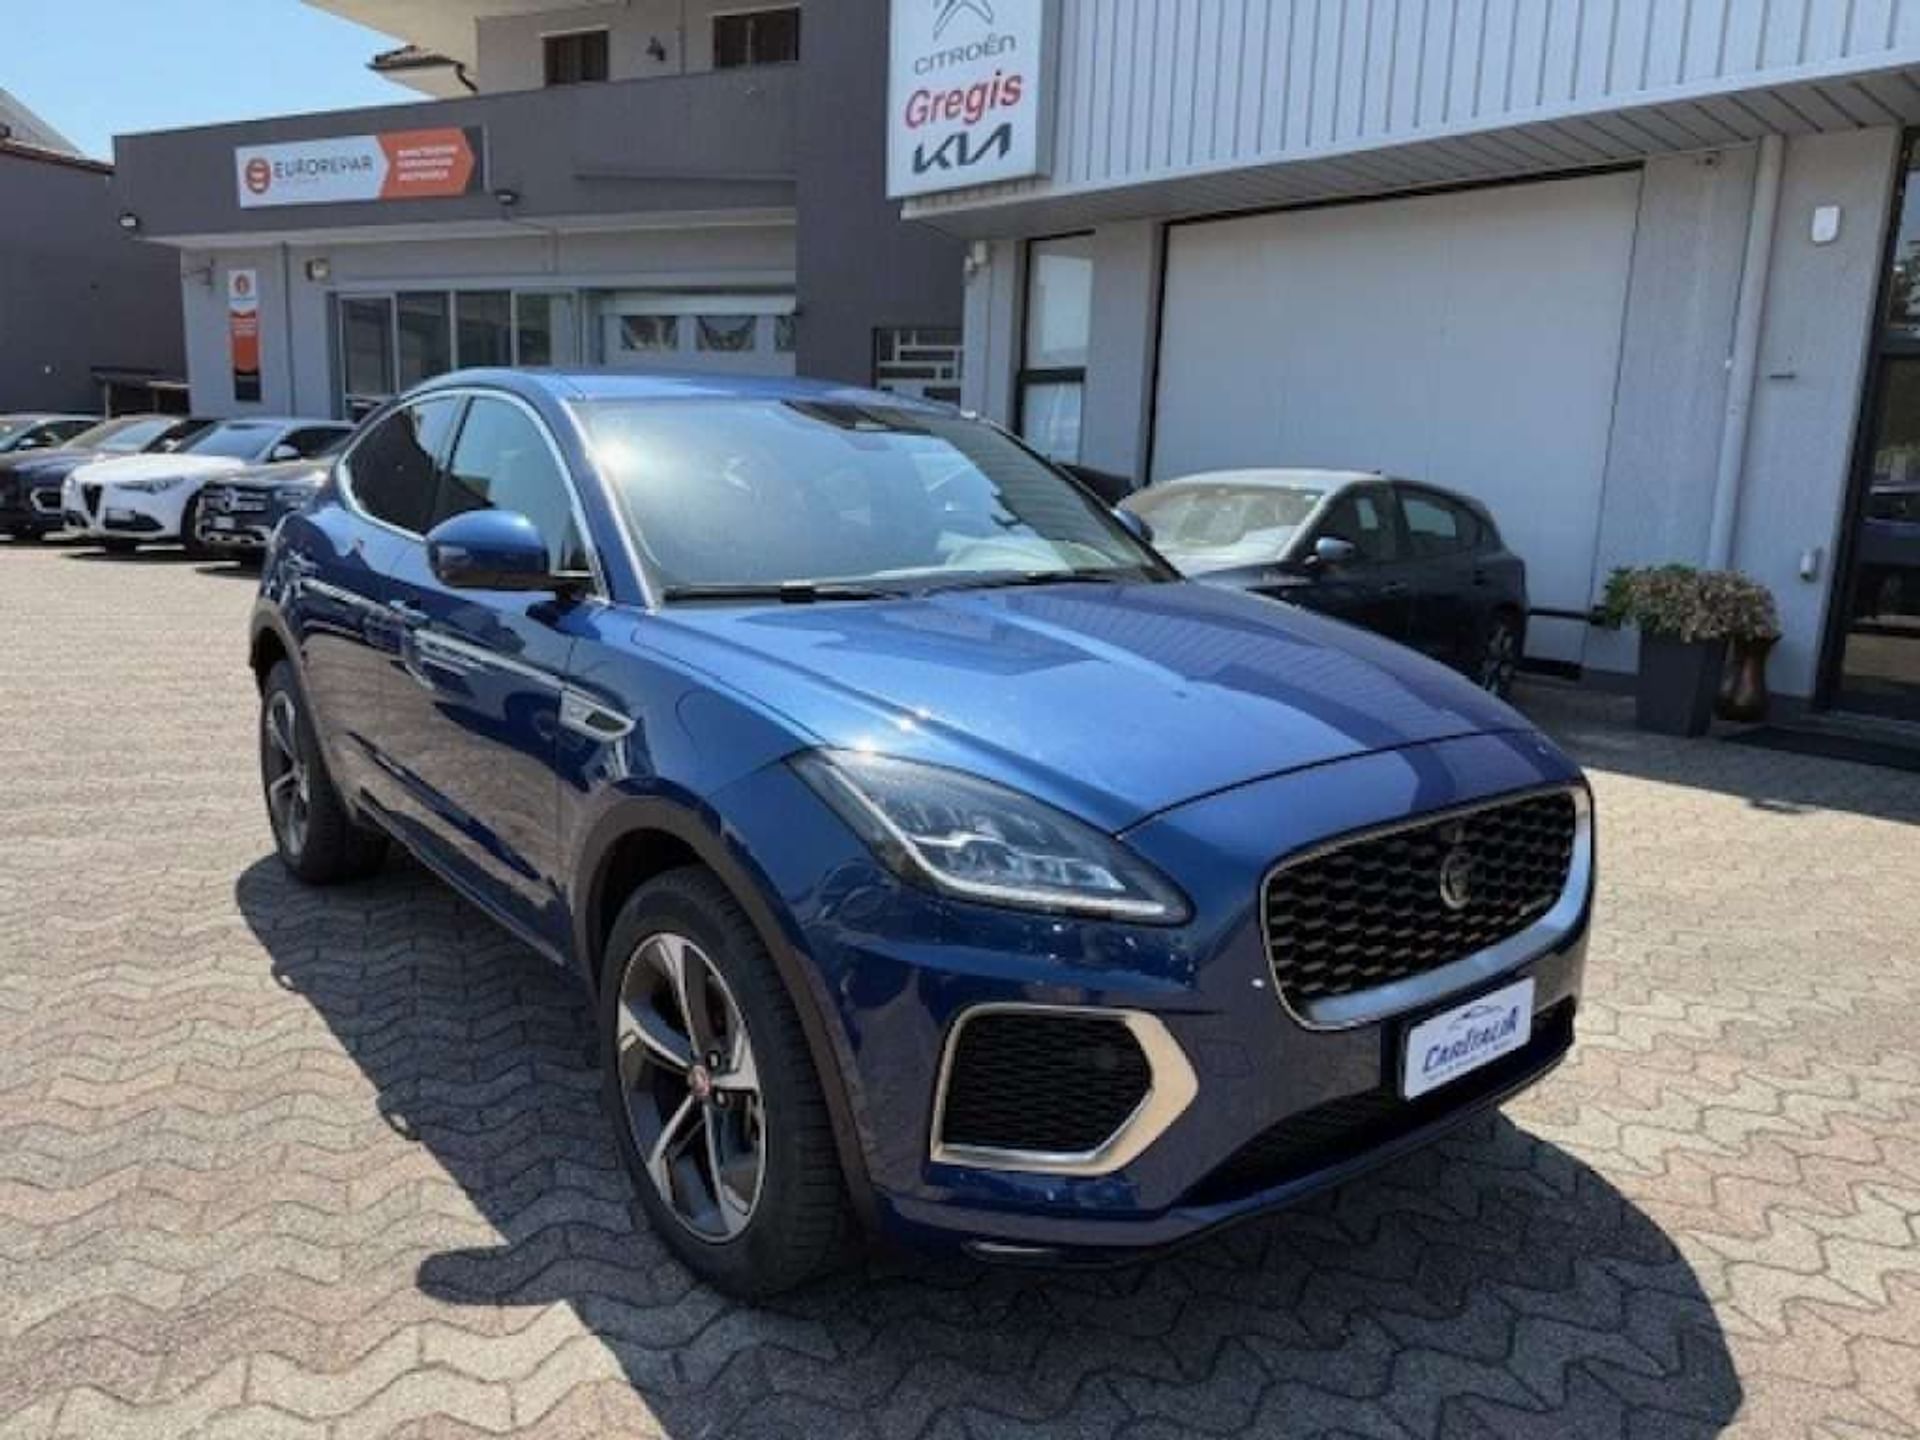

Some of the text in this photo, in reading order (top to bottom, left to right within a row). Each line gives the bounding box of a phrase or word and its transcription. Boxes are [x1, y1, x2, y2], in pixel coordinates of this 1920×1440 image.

[905, 70, 1022, 129] Gregis
[273, 156, 374, 180] EUROREPAR
[912, 122, 1012, 174] KIA
